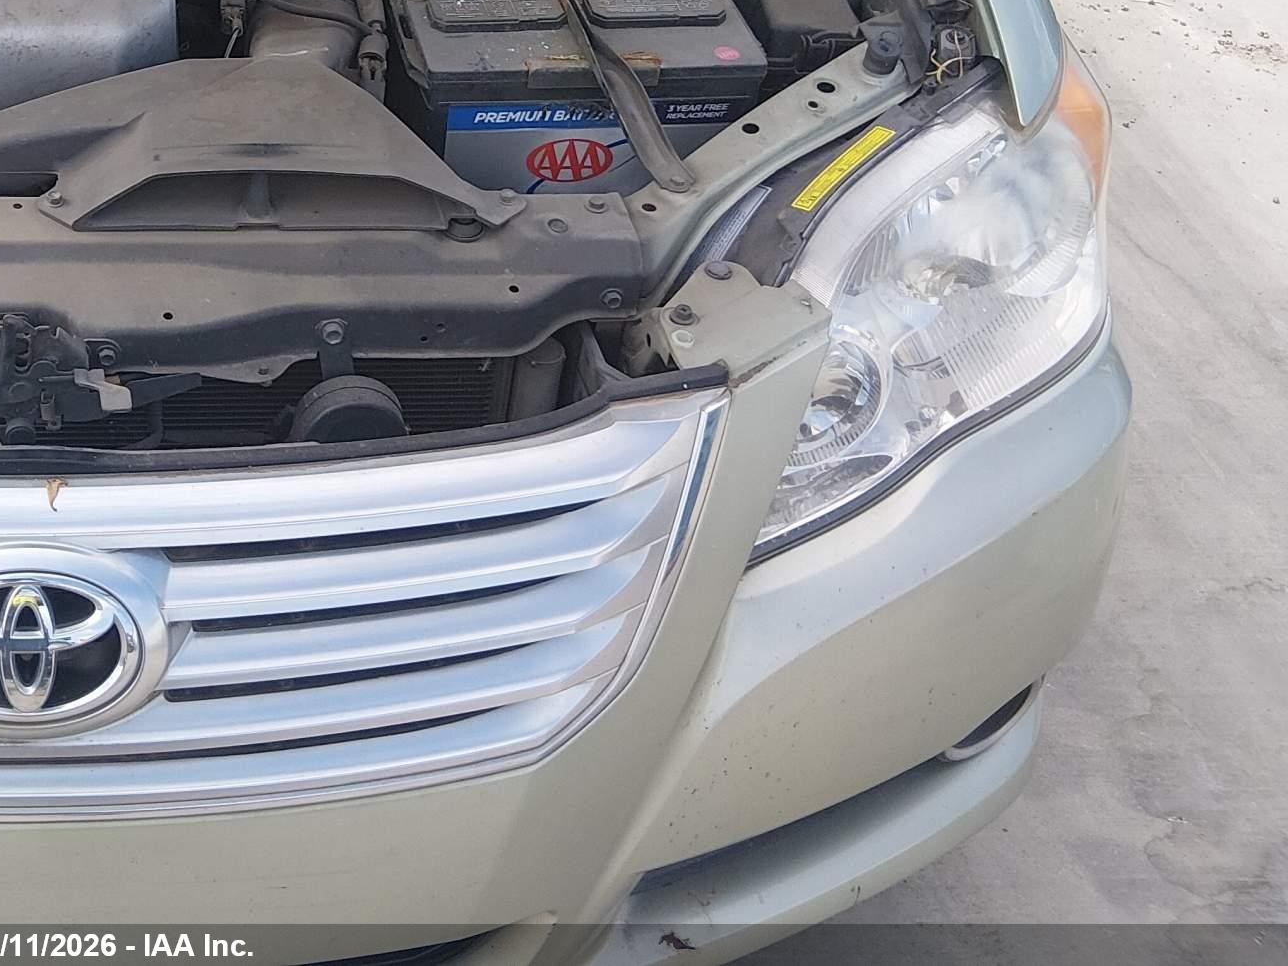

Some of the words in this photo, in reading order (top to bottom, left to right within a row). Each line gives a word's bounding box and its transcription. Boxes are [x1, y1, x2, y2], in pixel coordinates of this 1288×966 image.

[666, 104, 674, 112] 3
[676, 104, 702, 112] YEAR
[703, 103, 730, 111] FREE
[666, 111, 727, 119] REPLACEMENT
[536, 139, 603, 181] AAA
